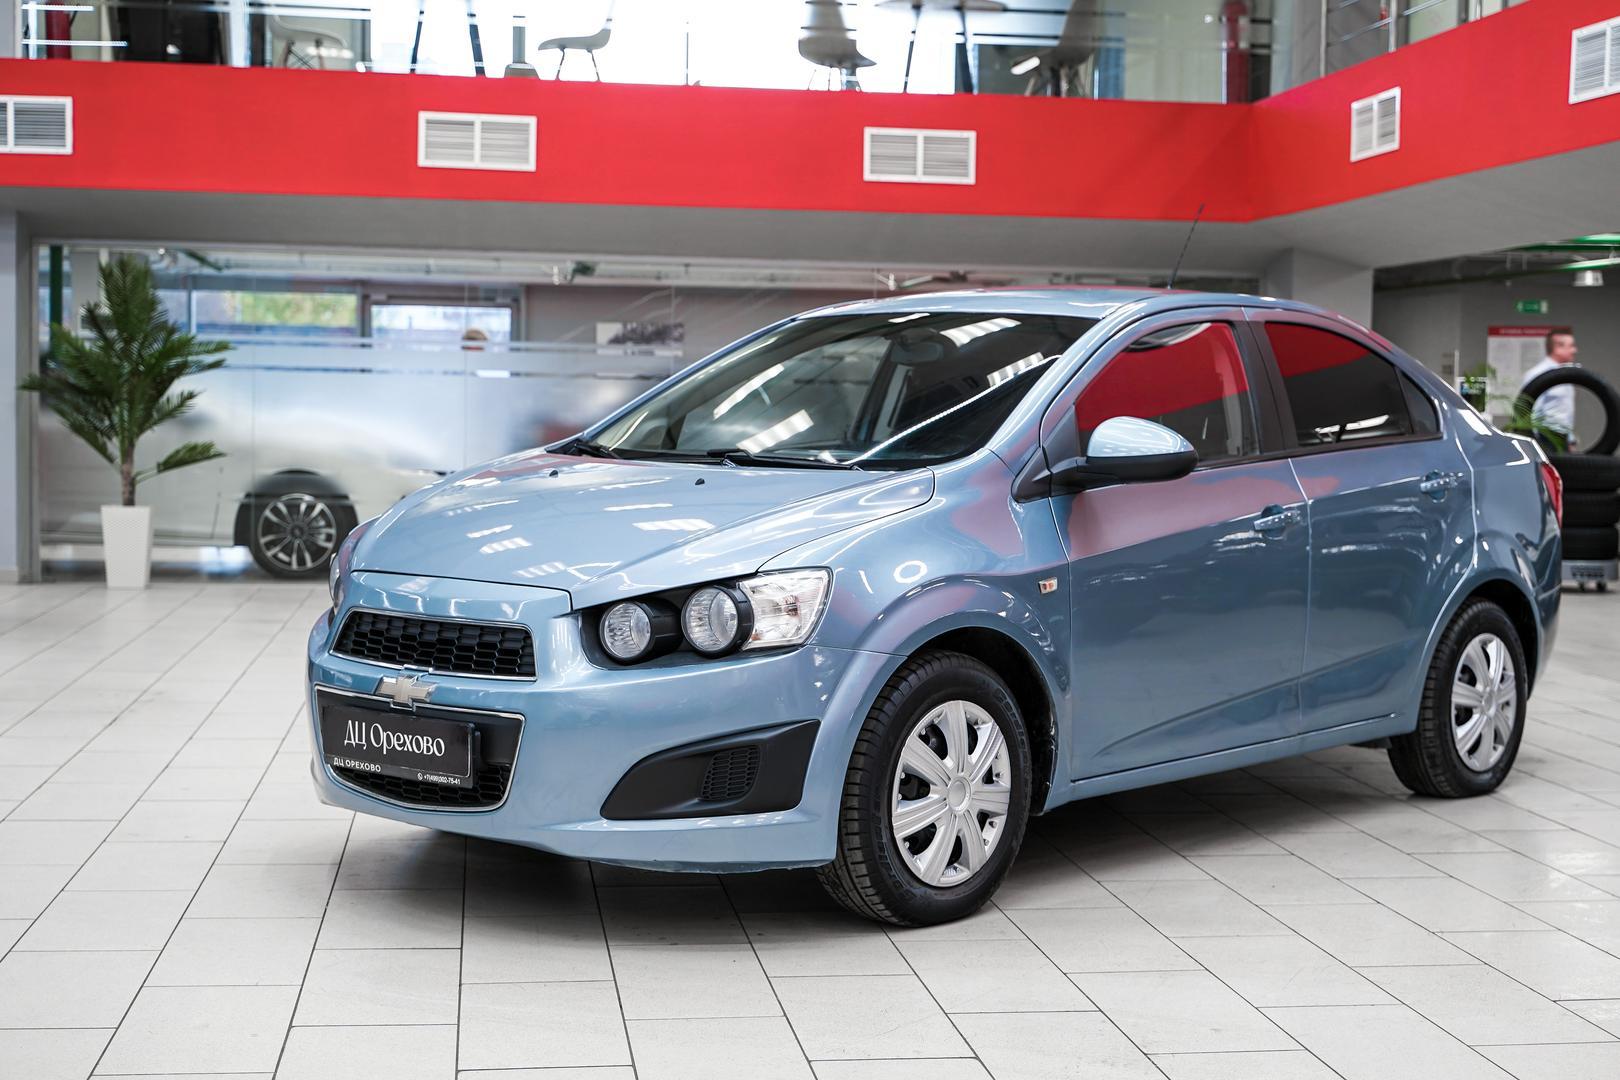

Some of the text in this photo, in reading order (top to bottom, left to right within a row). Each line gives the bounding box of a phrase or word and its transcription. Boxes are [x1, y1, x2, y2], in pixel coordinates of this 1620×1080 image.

[344, 719, 445, 757] ДЦ Орехово
[333, 757, 382, 773] ДЦ ОРЕХОВО
